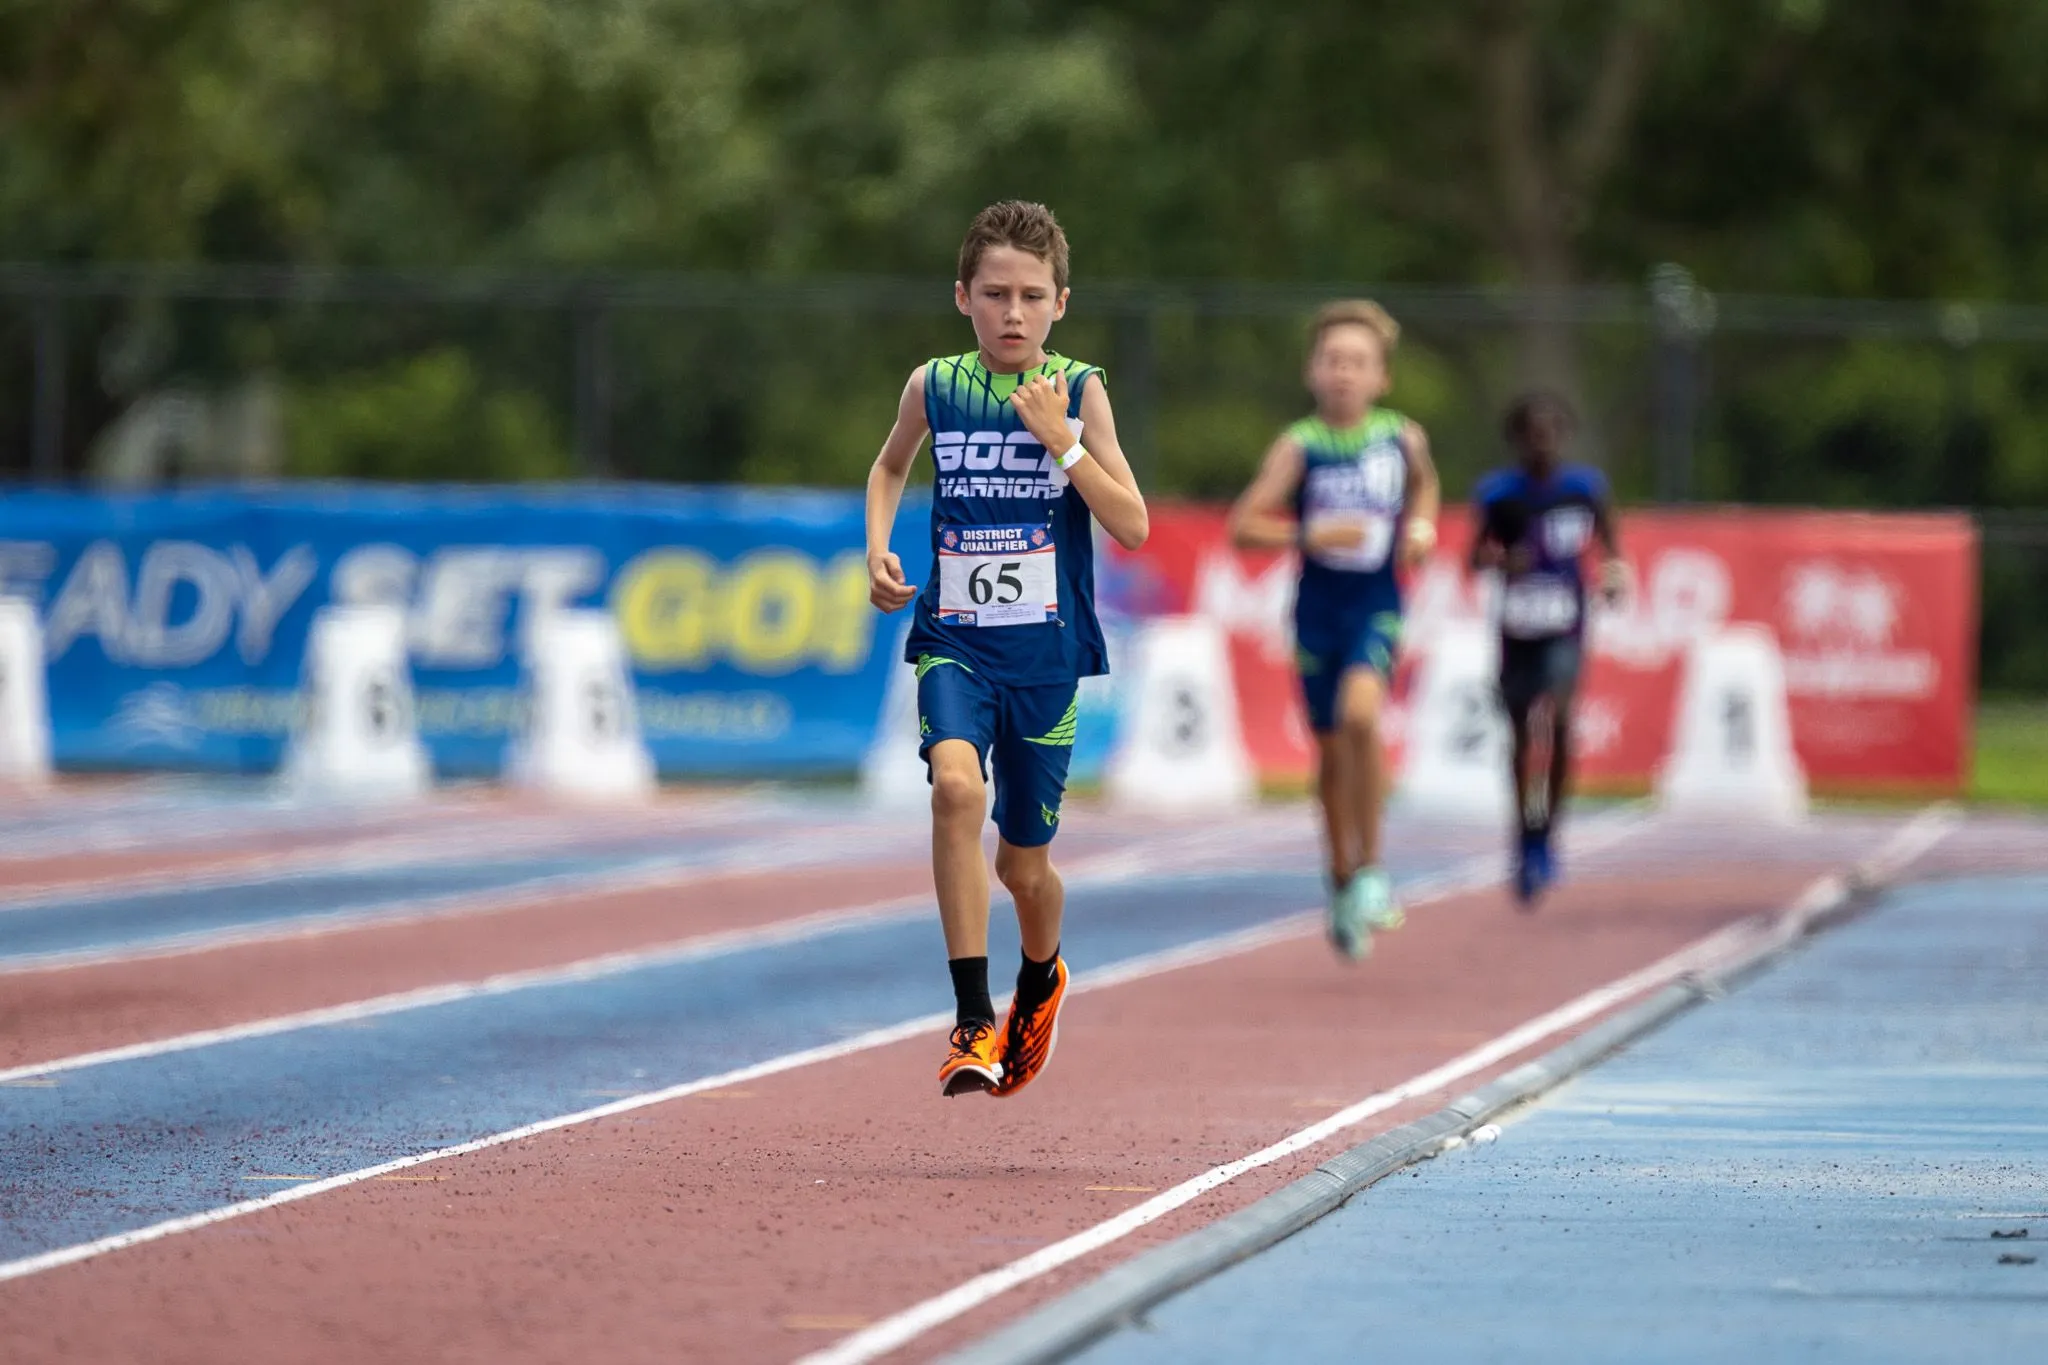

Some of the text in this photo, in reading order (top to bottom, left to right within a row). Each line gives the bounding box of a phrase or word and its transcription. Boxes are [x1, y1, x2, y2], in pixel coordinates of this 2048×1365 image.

[962, 528, 1023, 540] DISTRICT
[960, 540, 1028, 552] QUALIFIER
[968, 562, 1023, 605] 65
